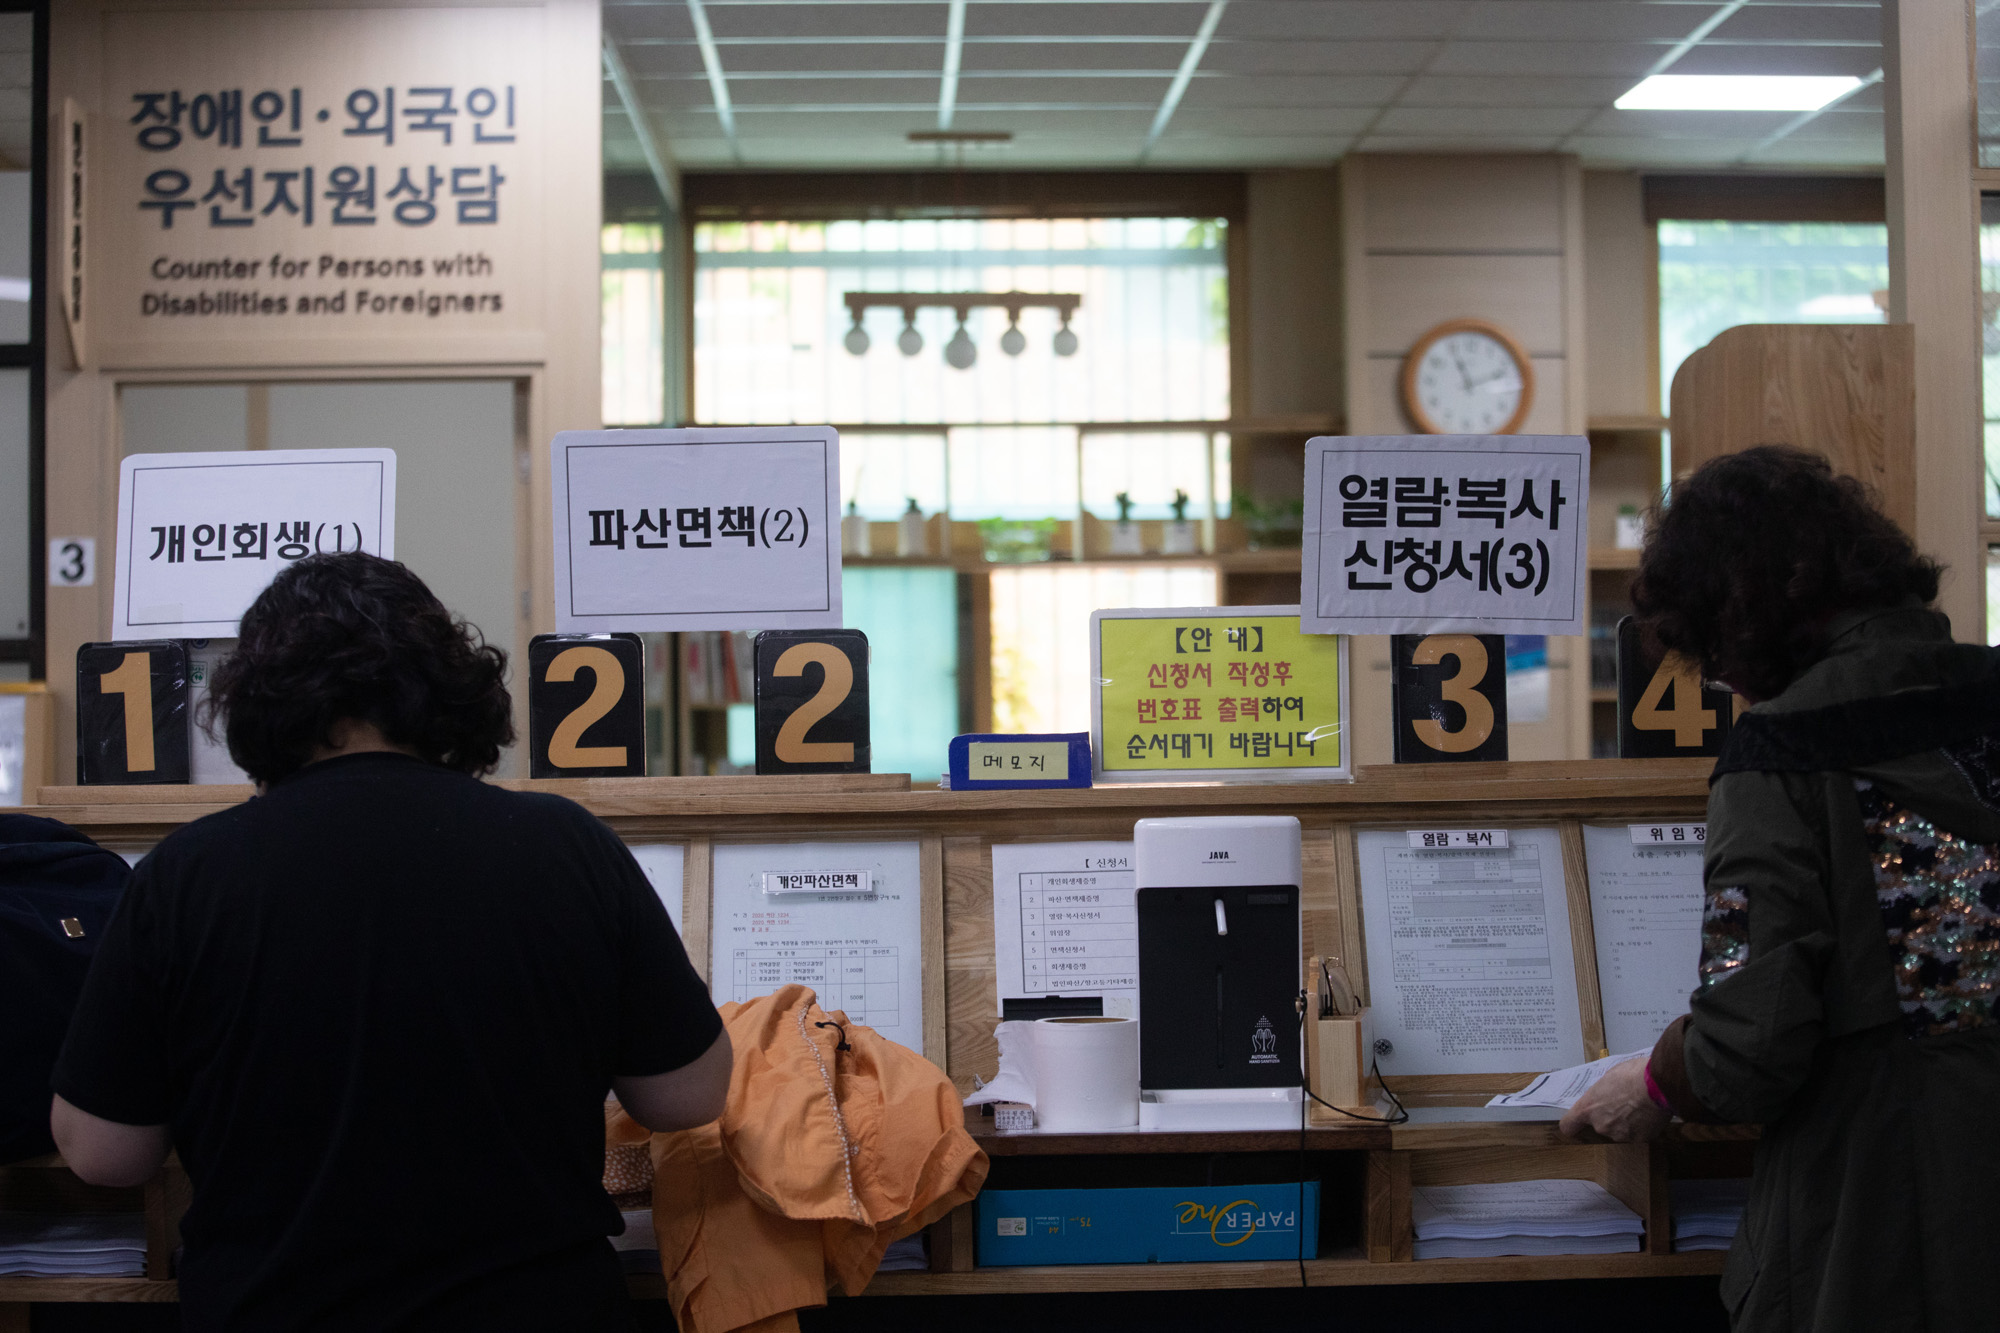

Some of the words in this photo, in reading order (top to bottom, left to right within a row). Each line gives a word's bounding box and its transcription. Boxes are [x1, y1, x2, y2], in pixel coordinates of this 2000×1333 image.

[130, 85, 517, 152] 장애인·외국인
[138, 164, 506, 229] 우선지원상담
[151, 255, 260, 280] Counter
[271, 255, 309, 280] for
[319, 256, 424, 279] Persons
[432, 252, 492, 277] with
[141, 291, 288, 316] Disabilities
[296, 291, 345, 315] and
[355, 289, 502, 318] Foreigners
[1339, 474, 1566, 531] 열람·복사
[149, 521, 363, 564] 개인회생(1)
[589, 506, 809, 550] 파산면책(2)
[58, 543, 86, 582] 3
[1344, 539, 1549, 597] 신청서(3)
[1147, 663, 1212, 689] 신청서
[1228, 661, 1293, 688] 작성후
[545, 647, 627, 768] 2
[772, 642, 855, 763] 2
[1137, 697, 1202, 724] 번호표
[1218, 697, 1304, 723] 출력하여
[1411, 634, 1494, 753] 3
[1631, 648, 1717, 747] 4
[100, 652, 156, 772] 1
[1126, 733, 1213, 759] 순서대기
[1230, 732, 1317, 758] 바랍니다
[1209, 851, 1229, 859] JAVA
[1422, 833, 1449, 847] 열람
[1467, 832, 1492, 846] 복사
[1097, 858, 1128, 868] 신청서
[777, 874, 858, 889] 개인파산면책
[1052, 978, 1137, 987] 법인파산/항고등기타제증
[1048, 1226, 1059, 1234] A4
[1080, 1217, 1091, 1227] 75
[1174, 1199, 1260, 1247] One
[1225, 1211, 1295, 1228] PAPER
